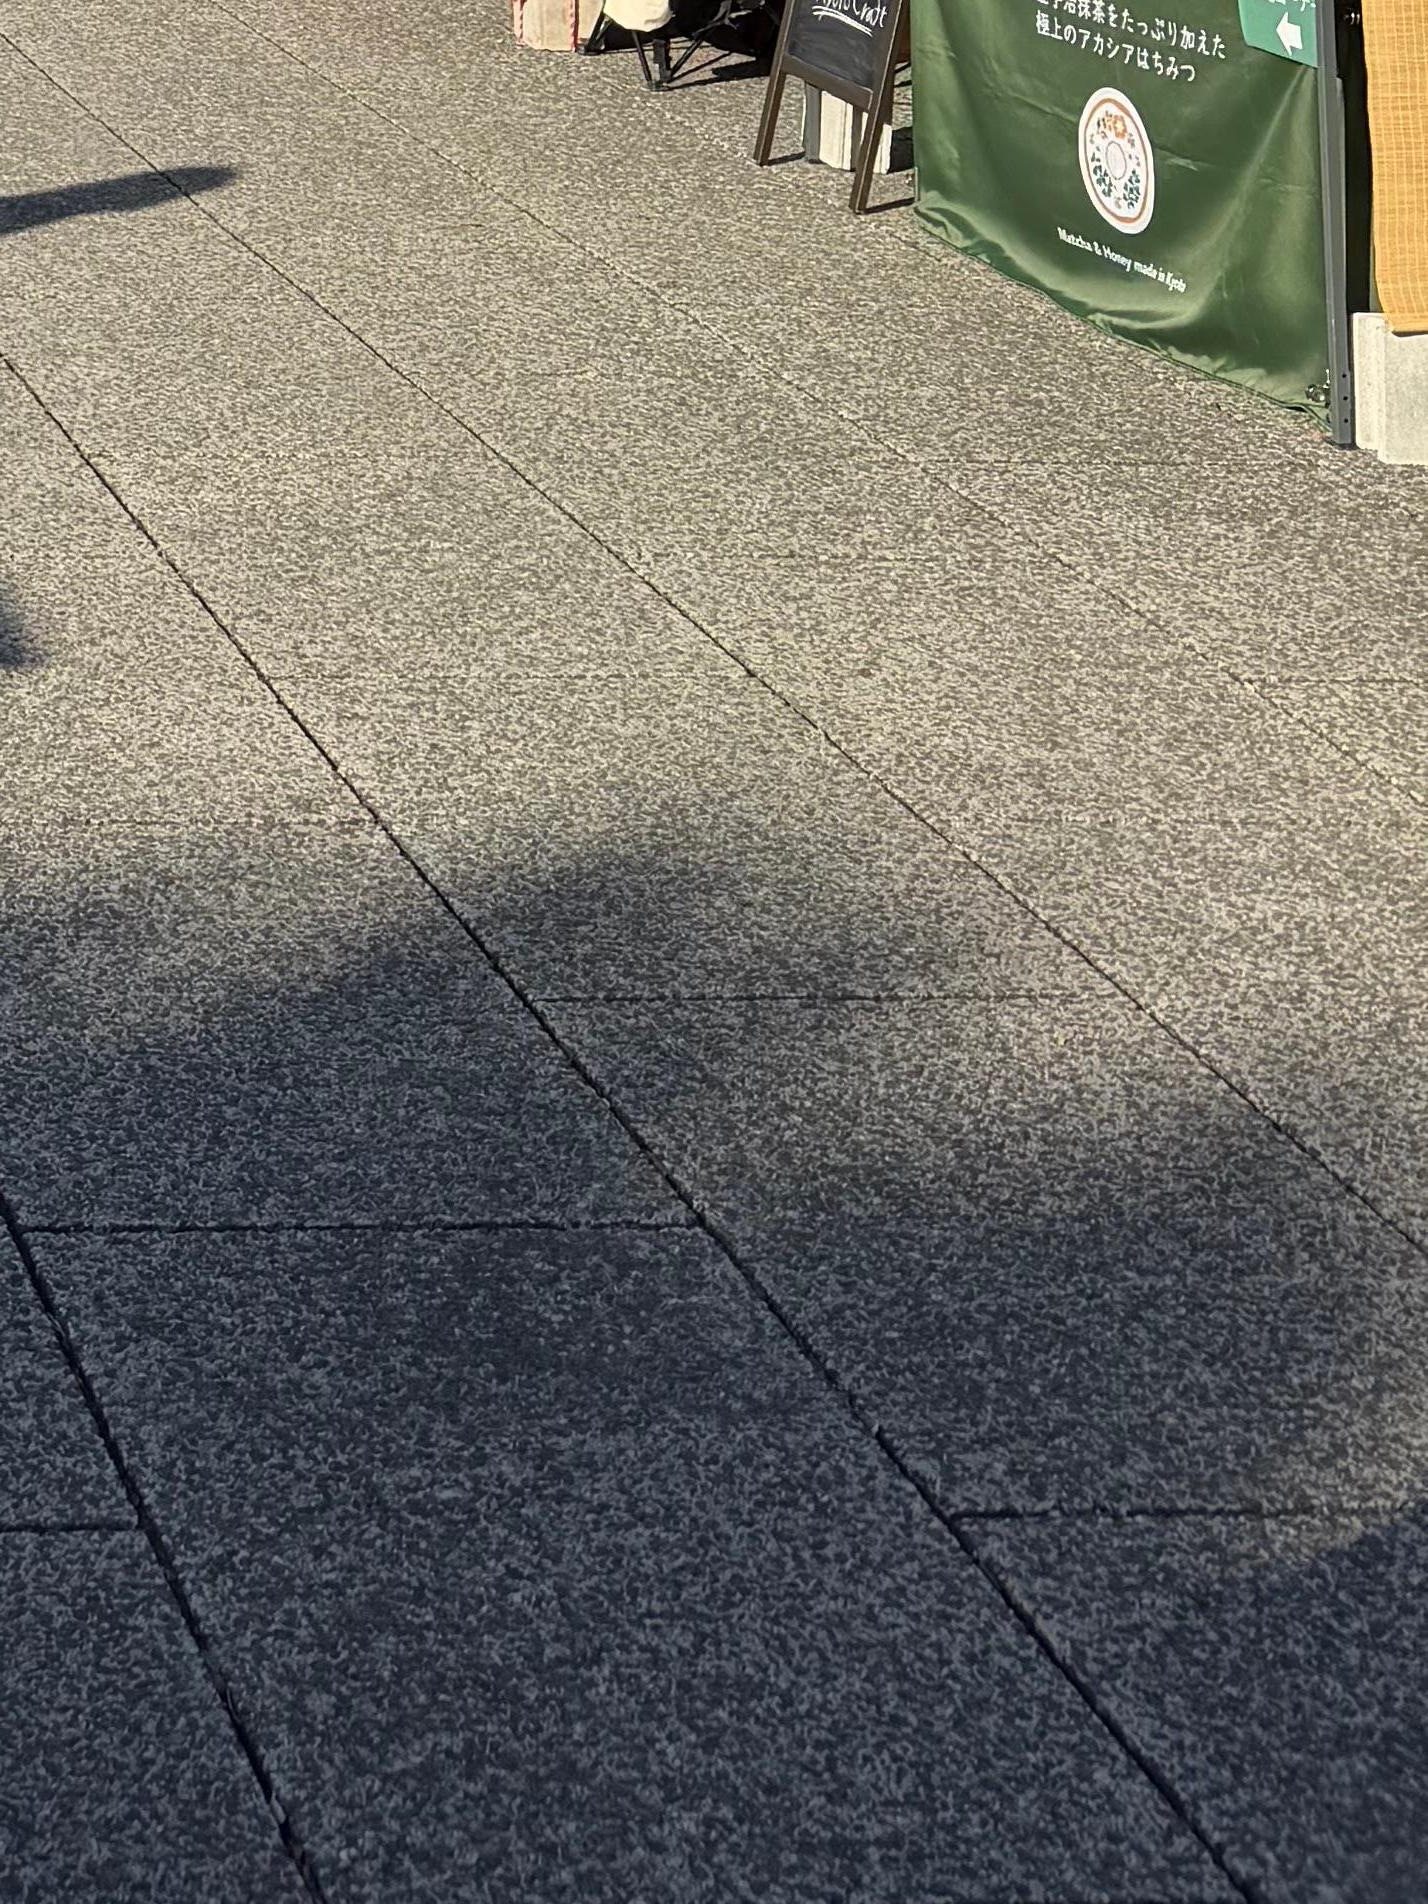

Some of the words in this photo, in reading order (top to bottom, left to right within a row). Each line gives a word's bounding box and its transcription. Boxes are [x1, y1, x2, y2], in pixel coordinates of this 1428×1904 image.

[1036, 9, 1196, 83] 極上のアカシアはちみつ
[1057, 226, 1093, 252] Matcha
[1102, 244, 1132, 273] Honey
[1133, 260, 1157, 281] made
